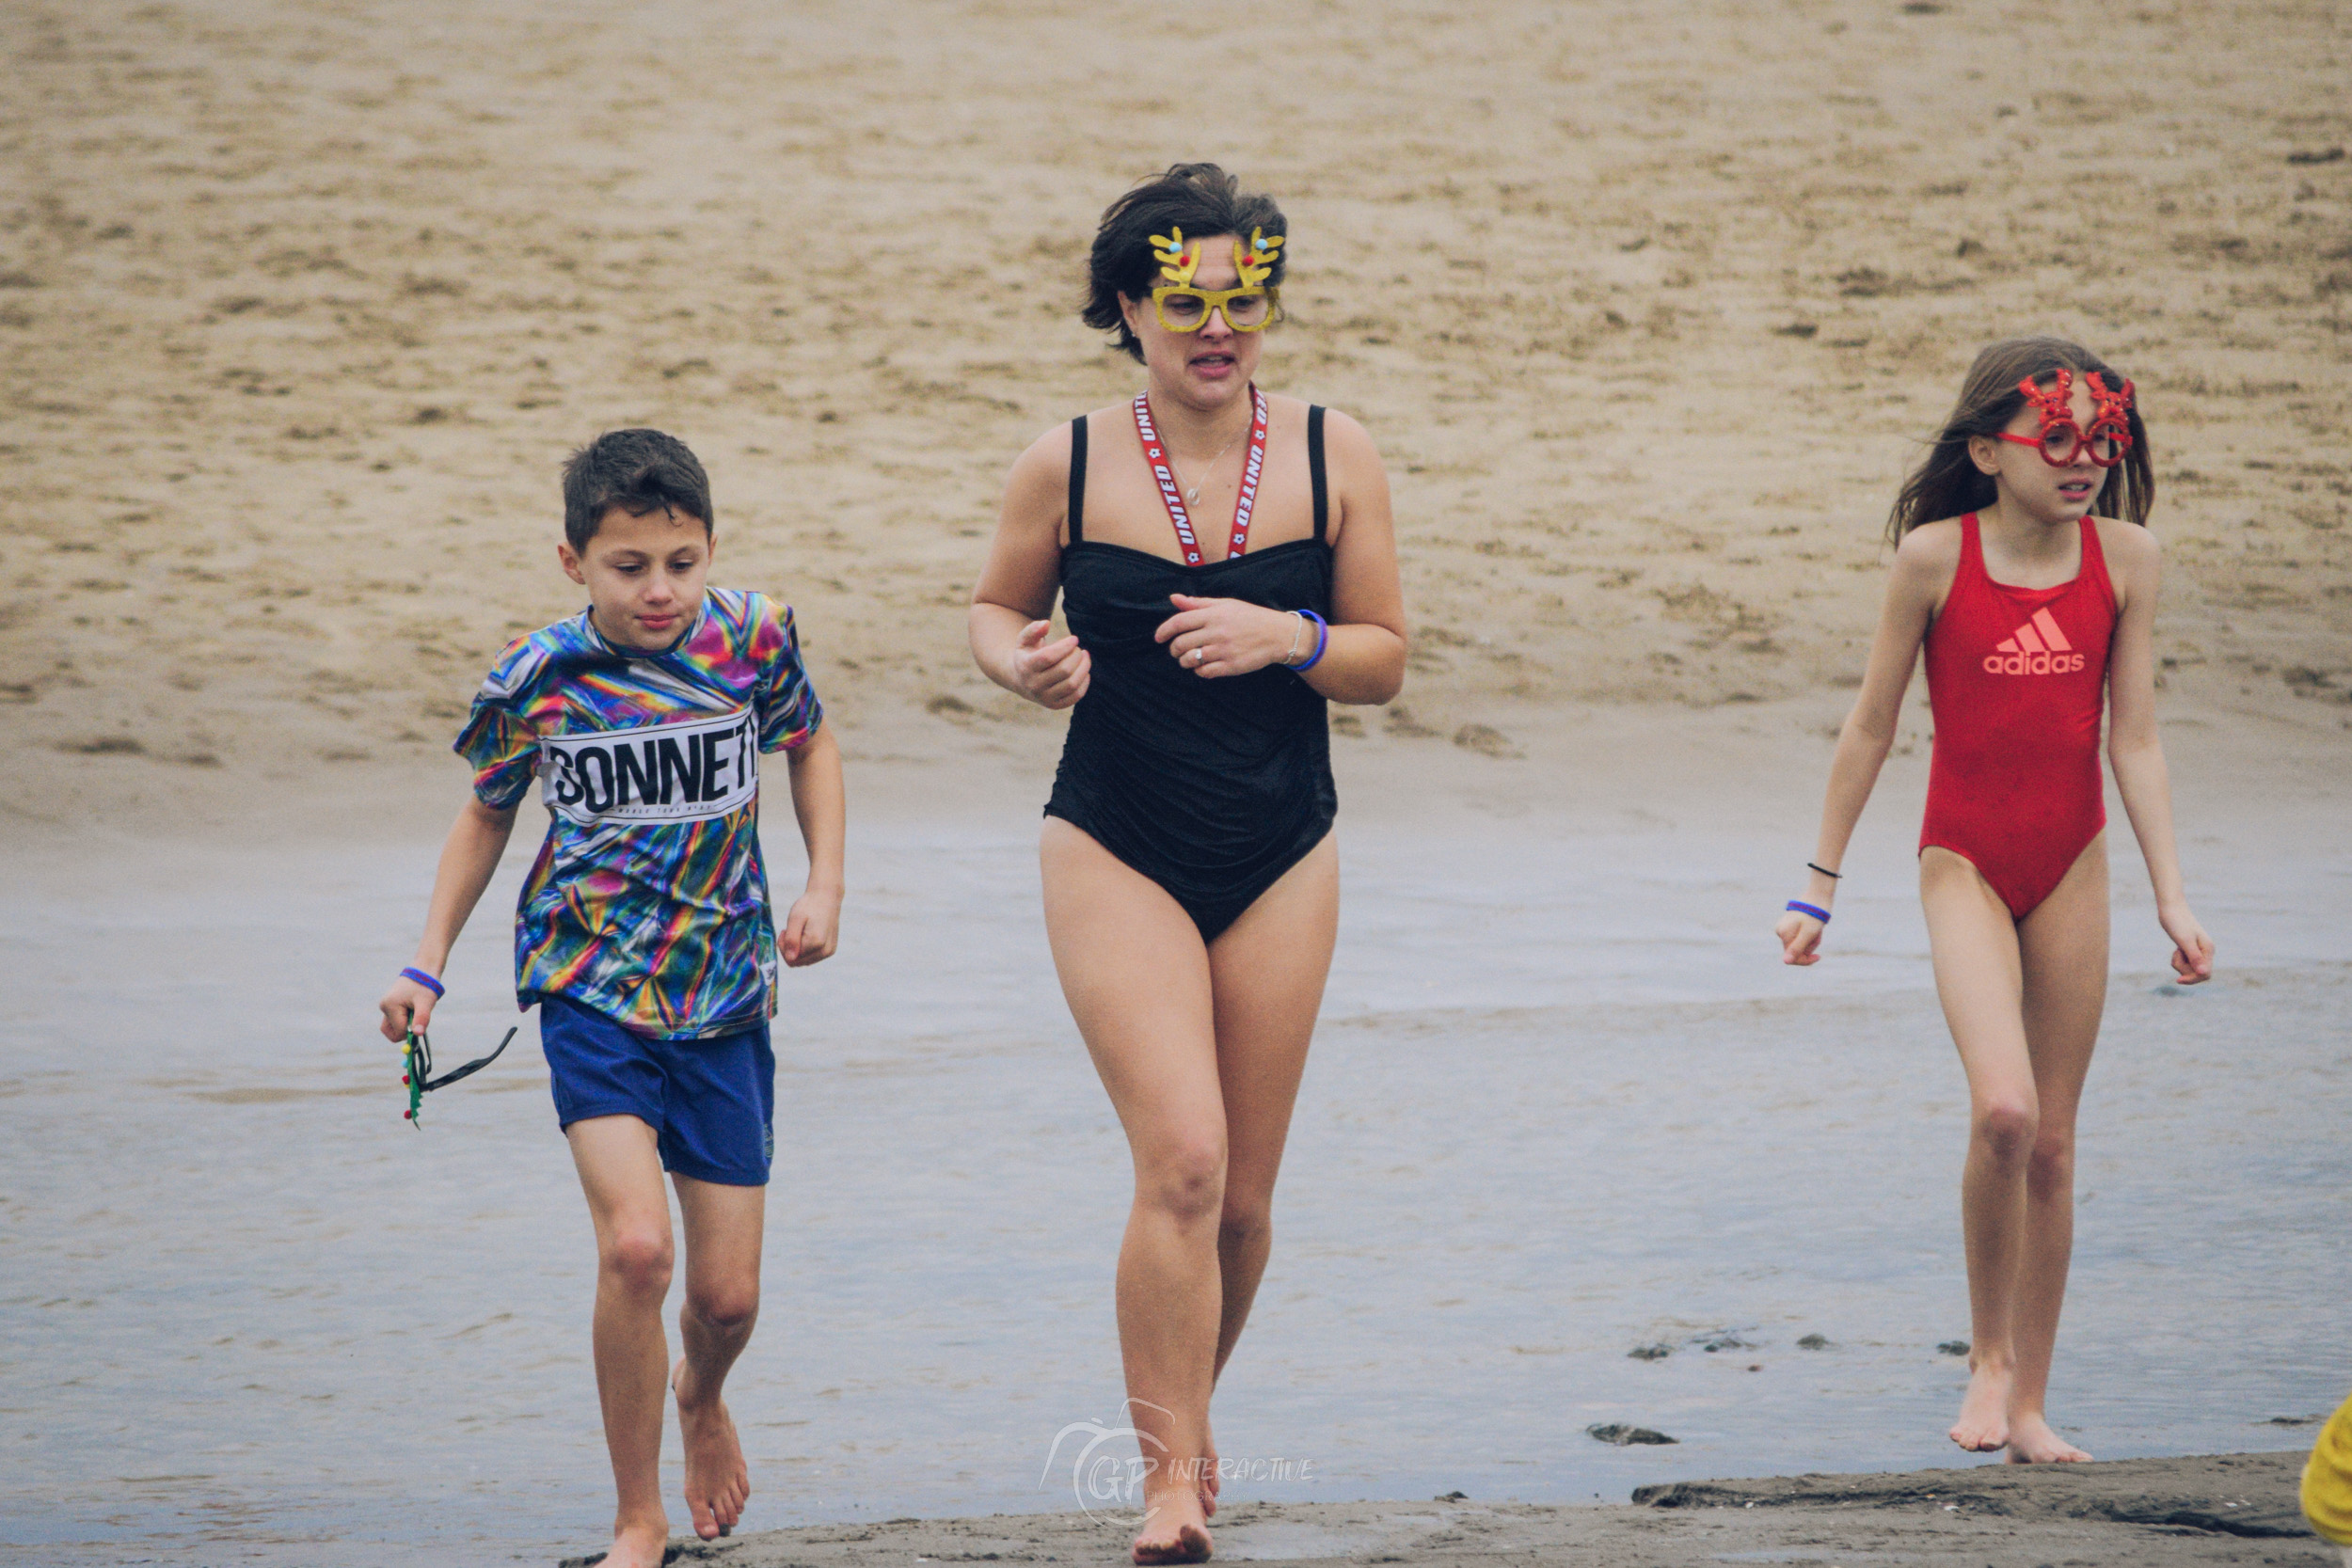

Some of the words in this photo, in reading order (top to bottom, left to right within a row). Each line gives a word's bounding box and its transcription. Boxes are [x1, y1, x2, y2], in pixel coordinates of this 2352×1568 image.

[1153, 465, 1196, 546] UNITED
[1235, 444, 1263, 527] UNITED
[1982, 650, 2085, 675] adidas
